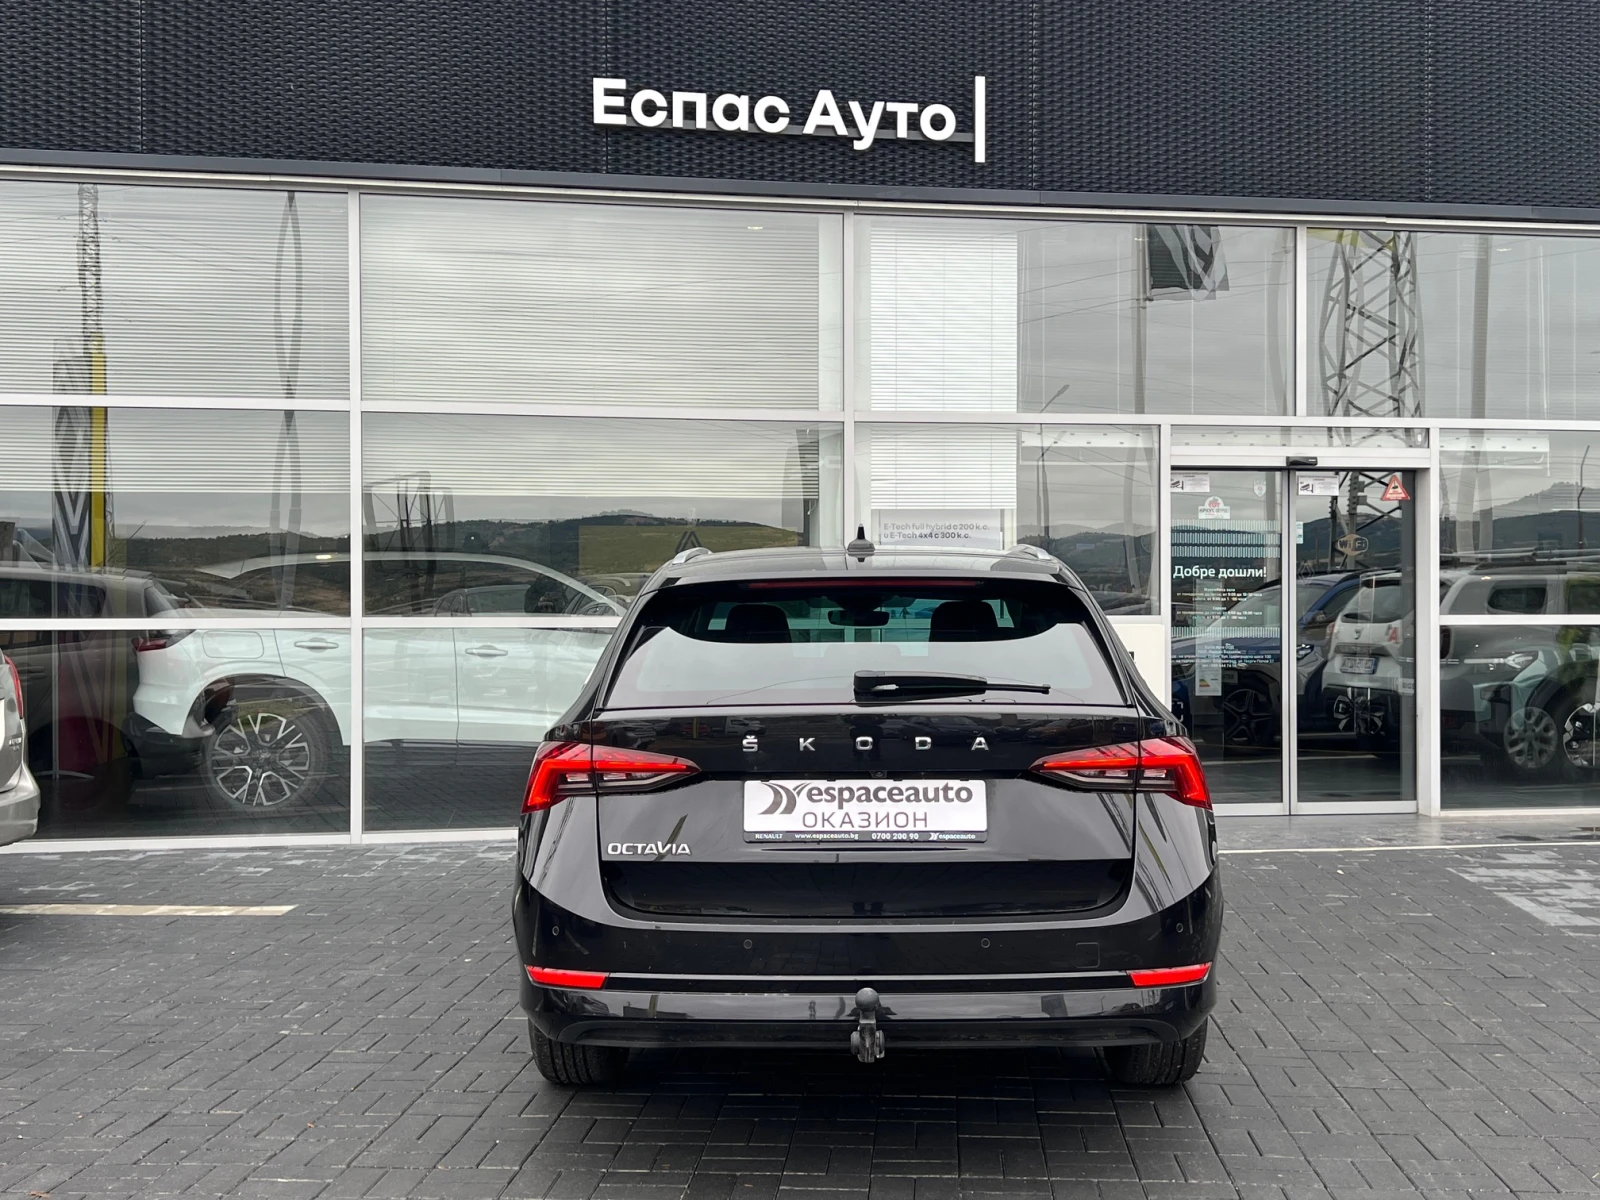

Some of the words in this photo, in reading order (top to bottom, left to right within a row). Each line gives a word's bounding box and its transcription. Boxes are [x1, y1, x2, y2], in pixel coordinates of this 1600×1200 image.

[592, 77, 790, 133] Еспас
[803, 89, 957, 151] Ауто
[883, 523, 911, 531] E-Tech
[911, 523, 925, 531] full
[925, 523, 952, 533] hybrid
[959, 523, 975, 531] 200
[1173, 565, 1216, 580] Добре
[1218, 566, 1267, 579] дошли!
[742, 735, 990, 751] ŠKODA
[806, 782, 973, 810] espaceauto
[802, 811, 928, 828] ОКАЗИОН
[794, 833, 859, 841] www.espaceauto.bg
[938, 833, 976, 841] espaceauto
[607, 841, 692, 855] OCTAVIA
